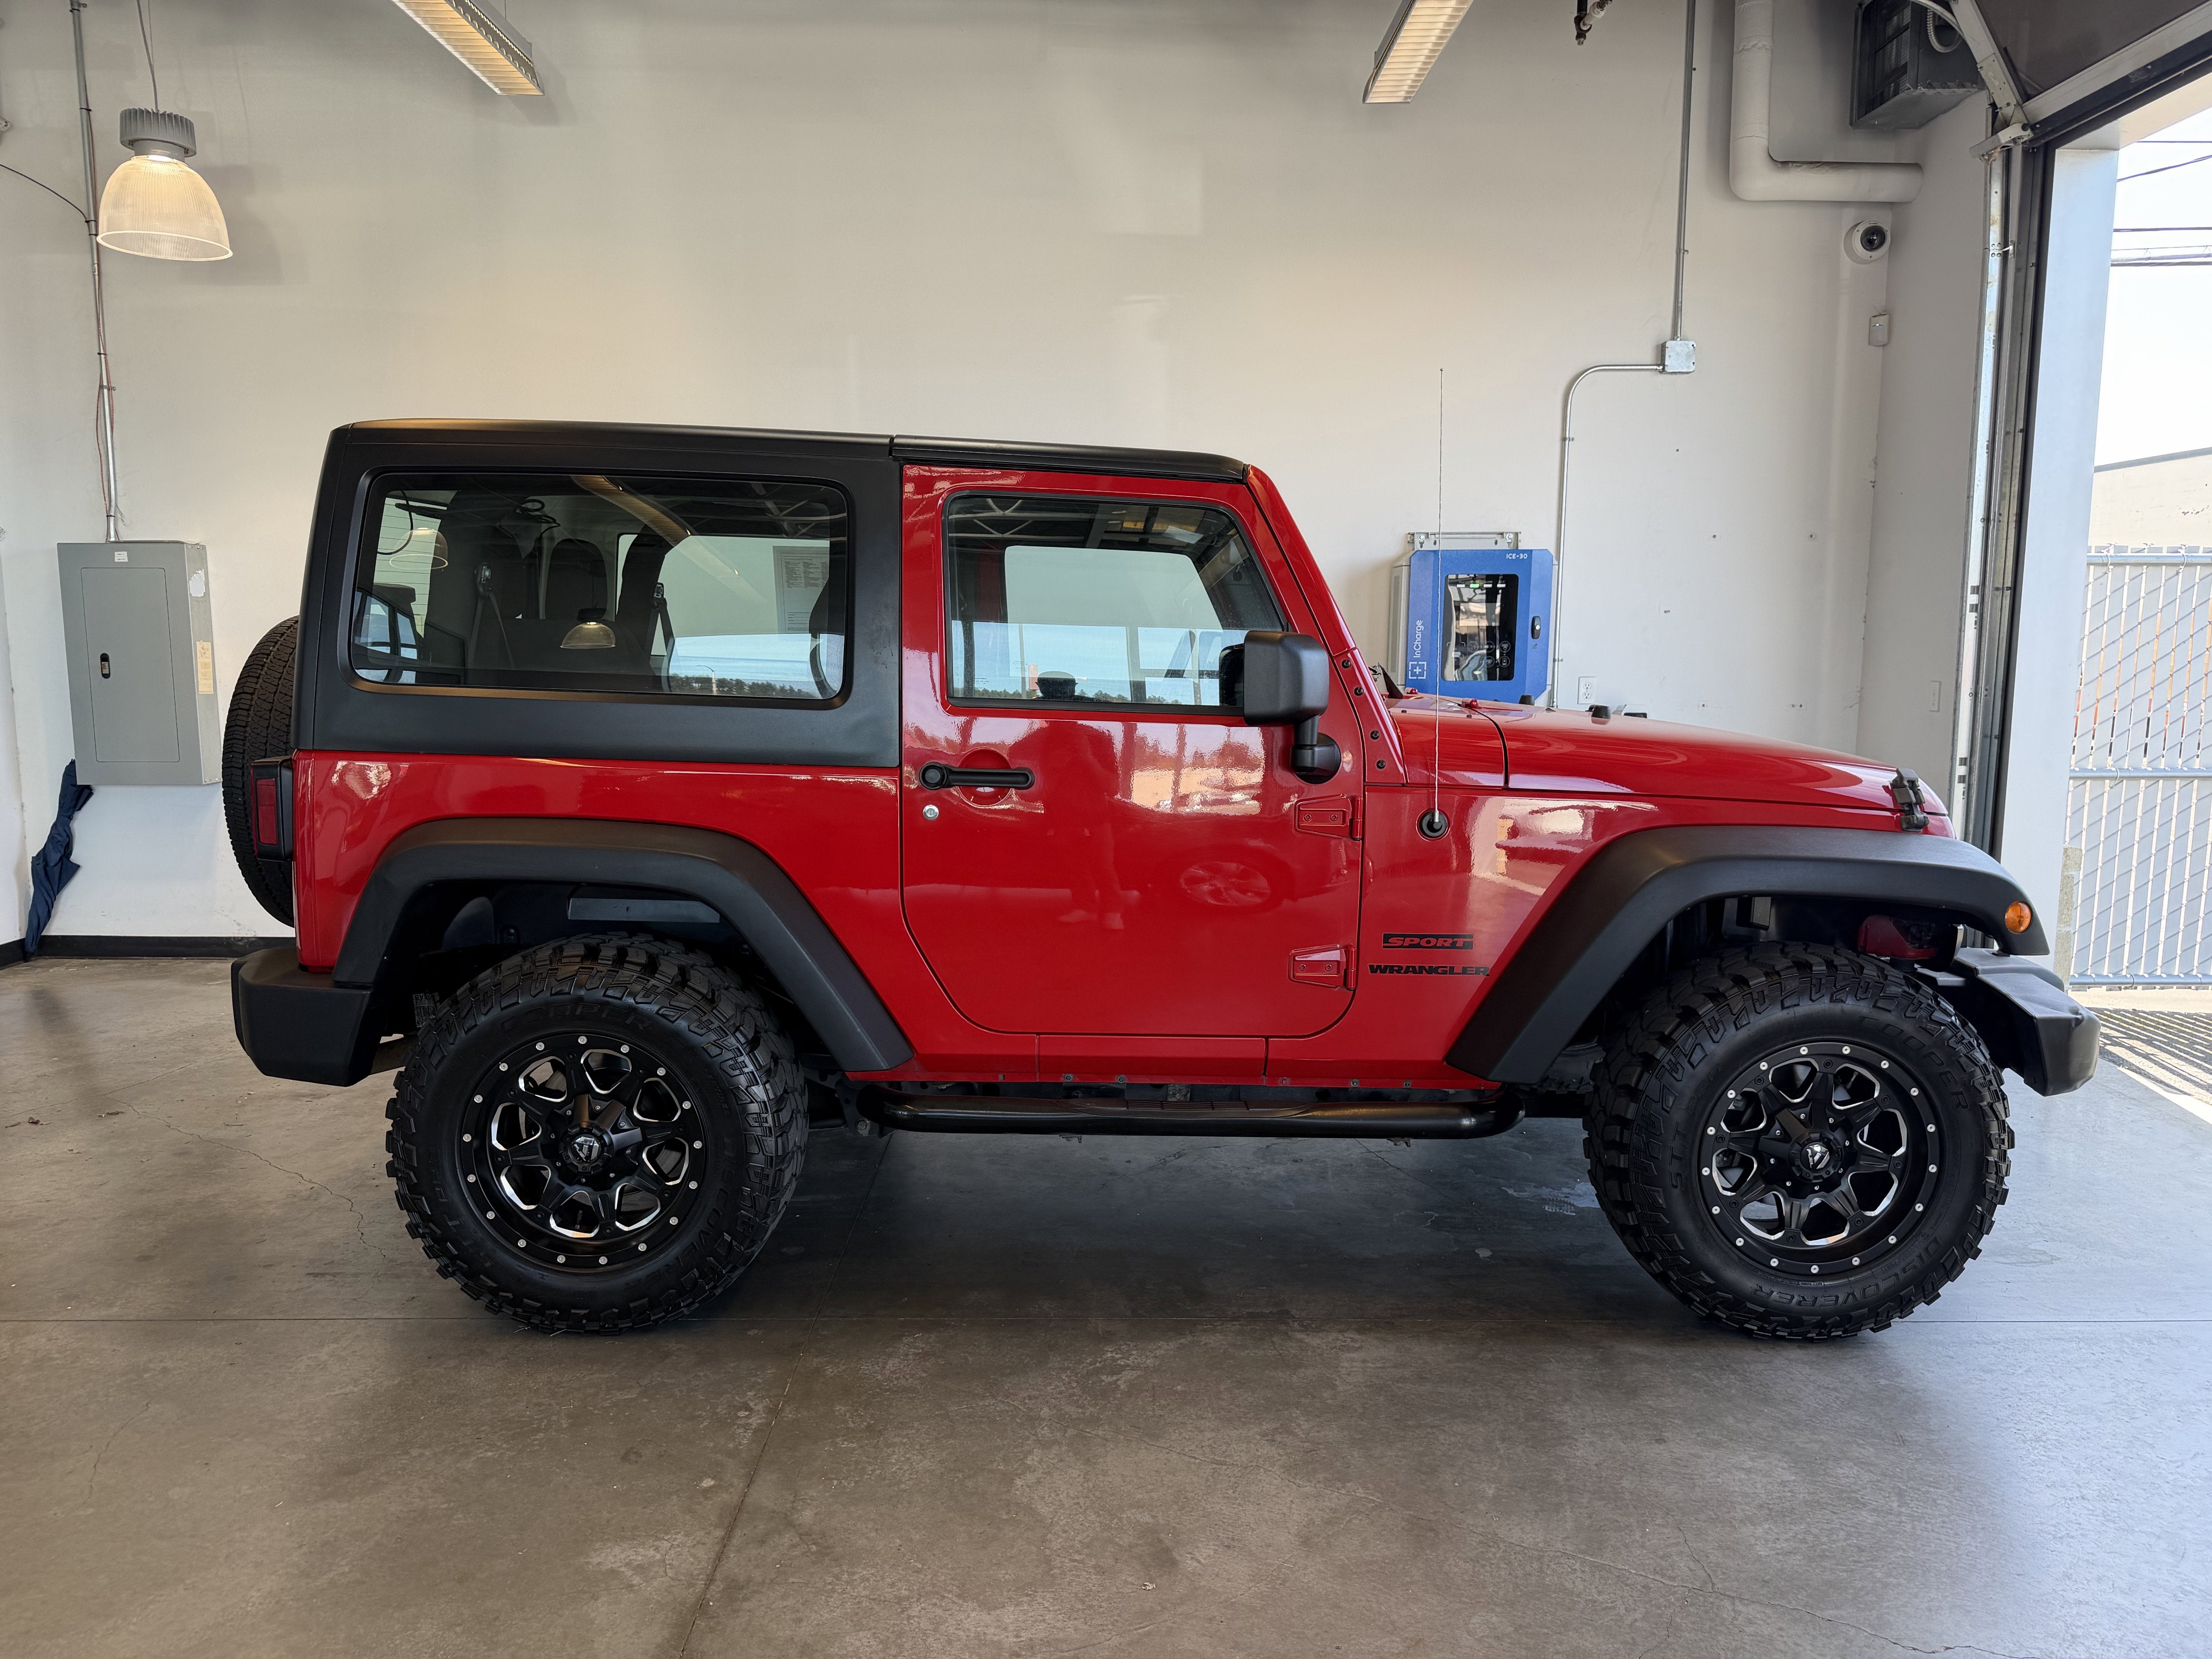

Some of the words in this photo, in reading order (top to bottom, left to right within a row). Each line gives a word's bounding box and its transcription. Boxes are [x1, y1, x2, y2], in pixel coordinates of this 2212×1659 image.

[1413, 620, 1424, 658] InCharge
[1383, 934, 1473, 948] SPORT
[1368, 964, 1491, 976] WRANGLER
[501, 1002, 653, 1031] COOPER
[1858, 1016, 1969, 1109] COOPER
[1669, 1121, 1685, 1191] STT
[1685, 1064, 1721, 1116] PRO
[624, 1137, 735, 1294] DISCOVERER
[1752, 1237, 1942, 1308] DISCOVERER
